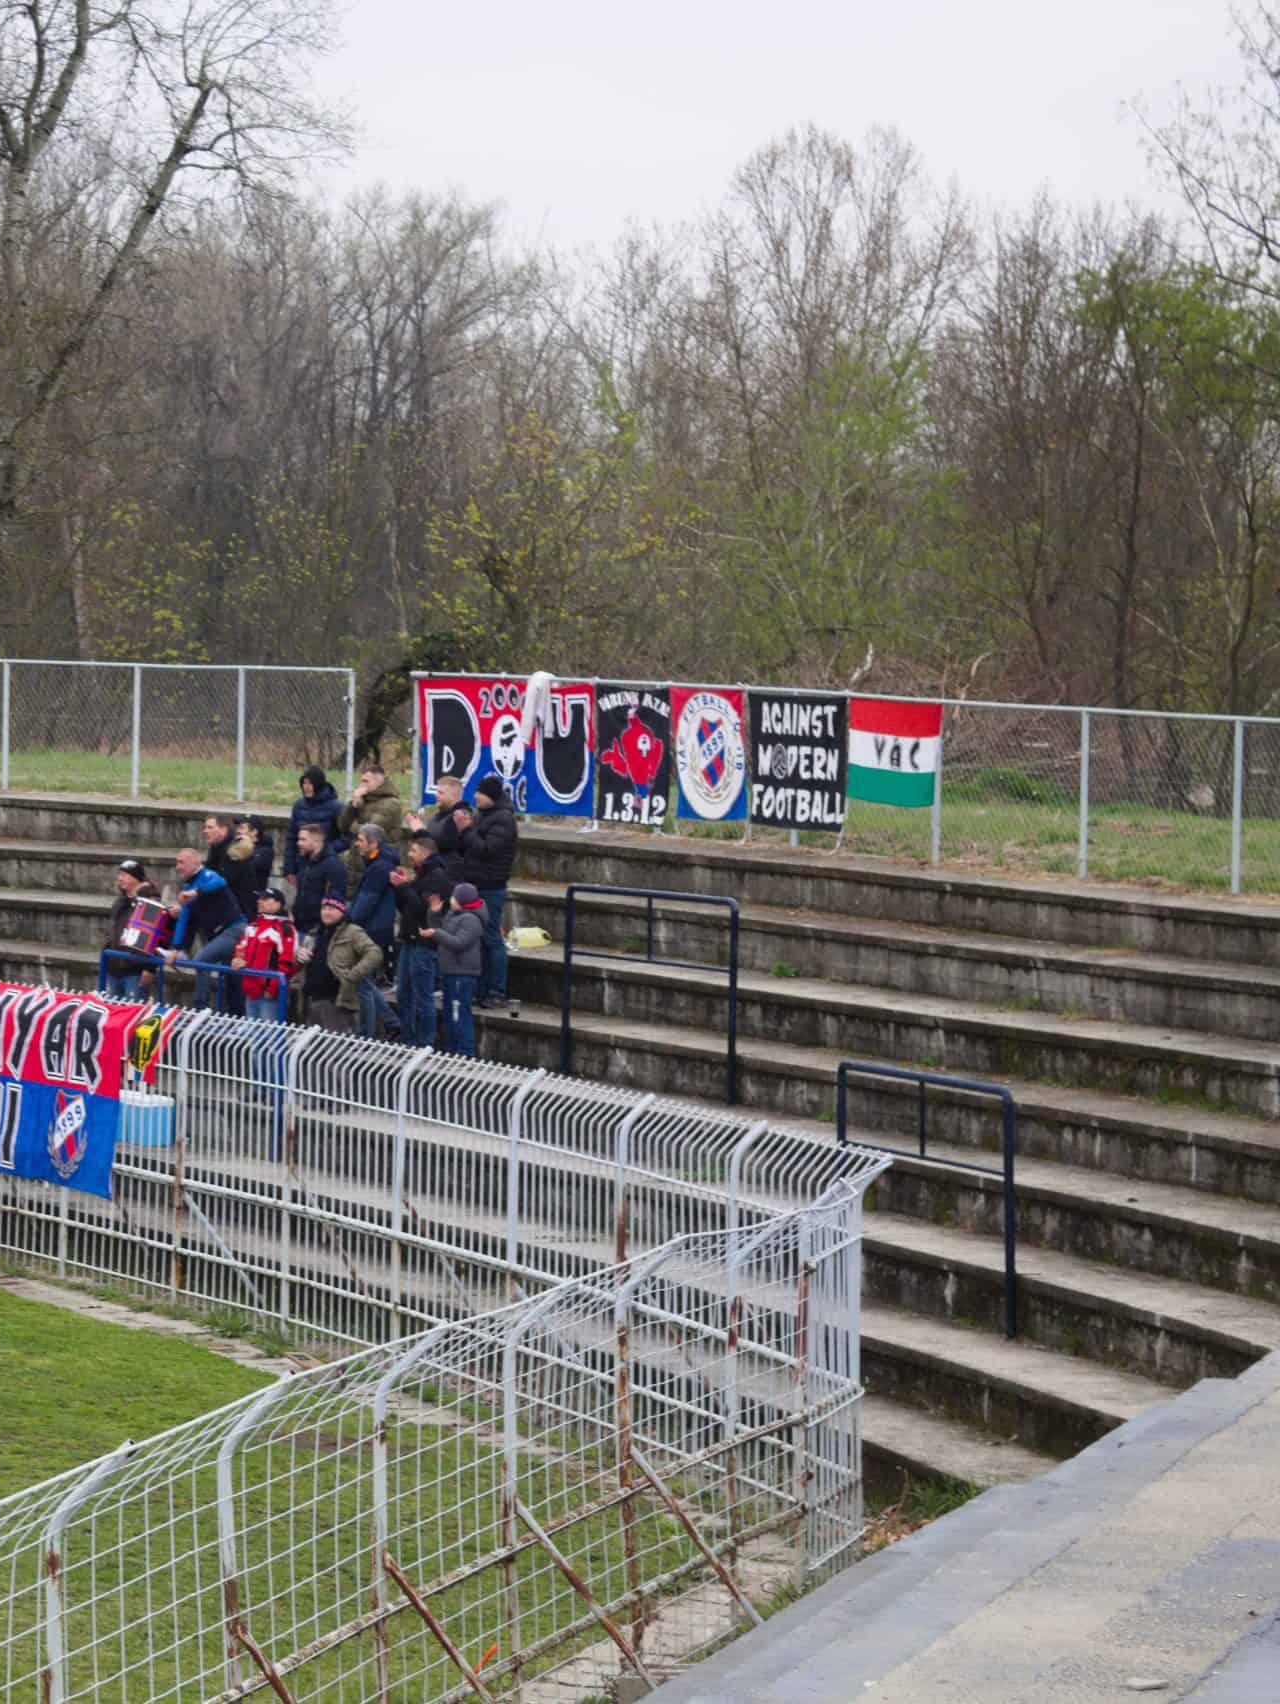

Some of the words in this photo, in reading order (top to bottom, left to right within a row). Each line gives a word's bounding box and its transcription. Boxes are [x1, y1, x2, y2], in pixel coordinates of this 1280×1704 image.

[479, 682, 528, 718] 200
[761, 702, 838, 737] AGAINST
[758, 743, 839, 781] MODERN
[603, 792, 666, 825] 1.3.12
[752, 784, 845, 825] FOOTBALL
